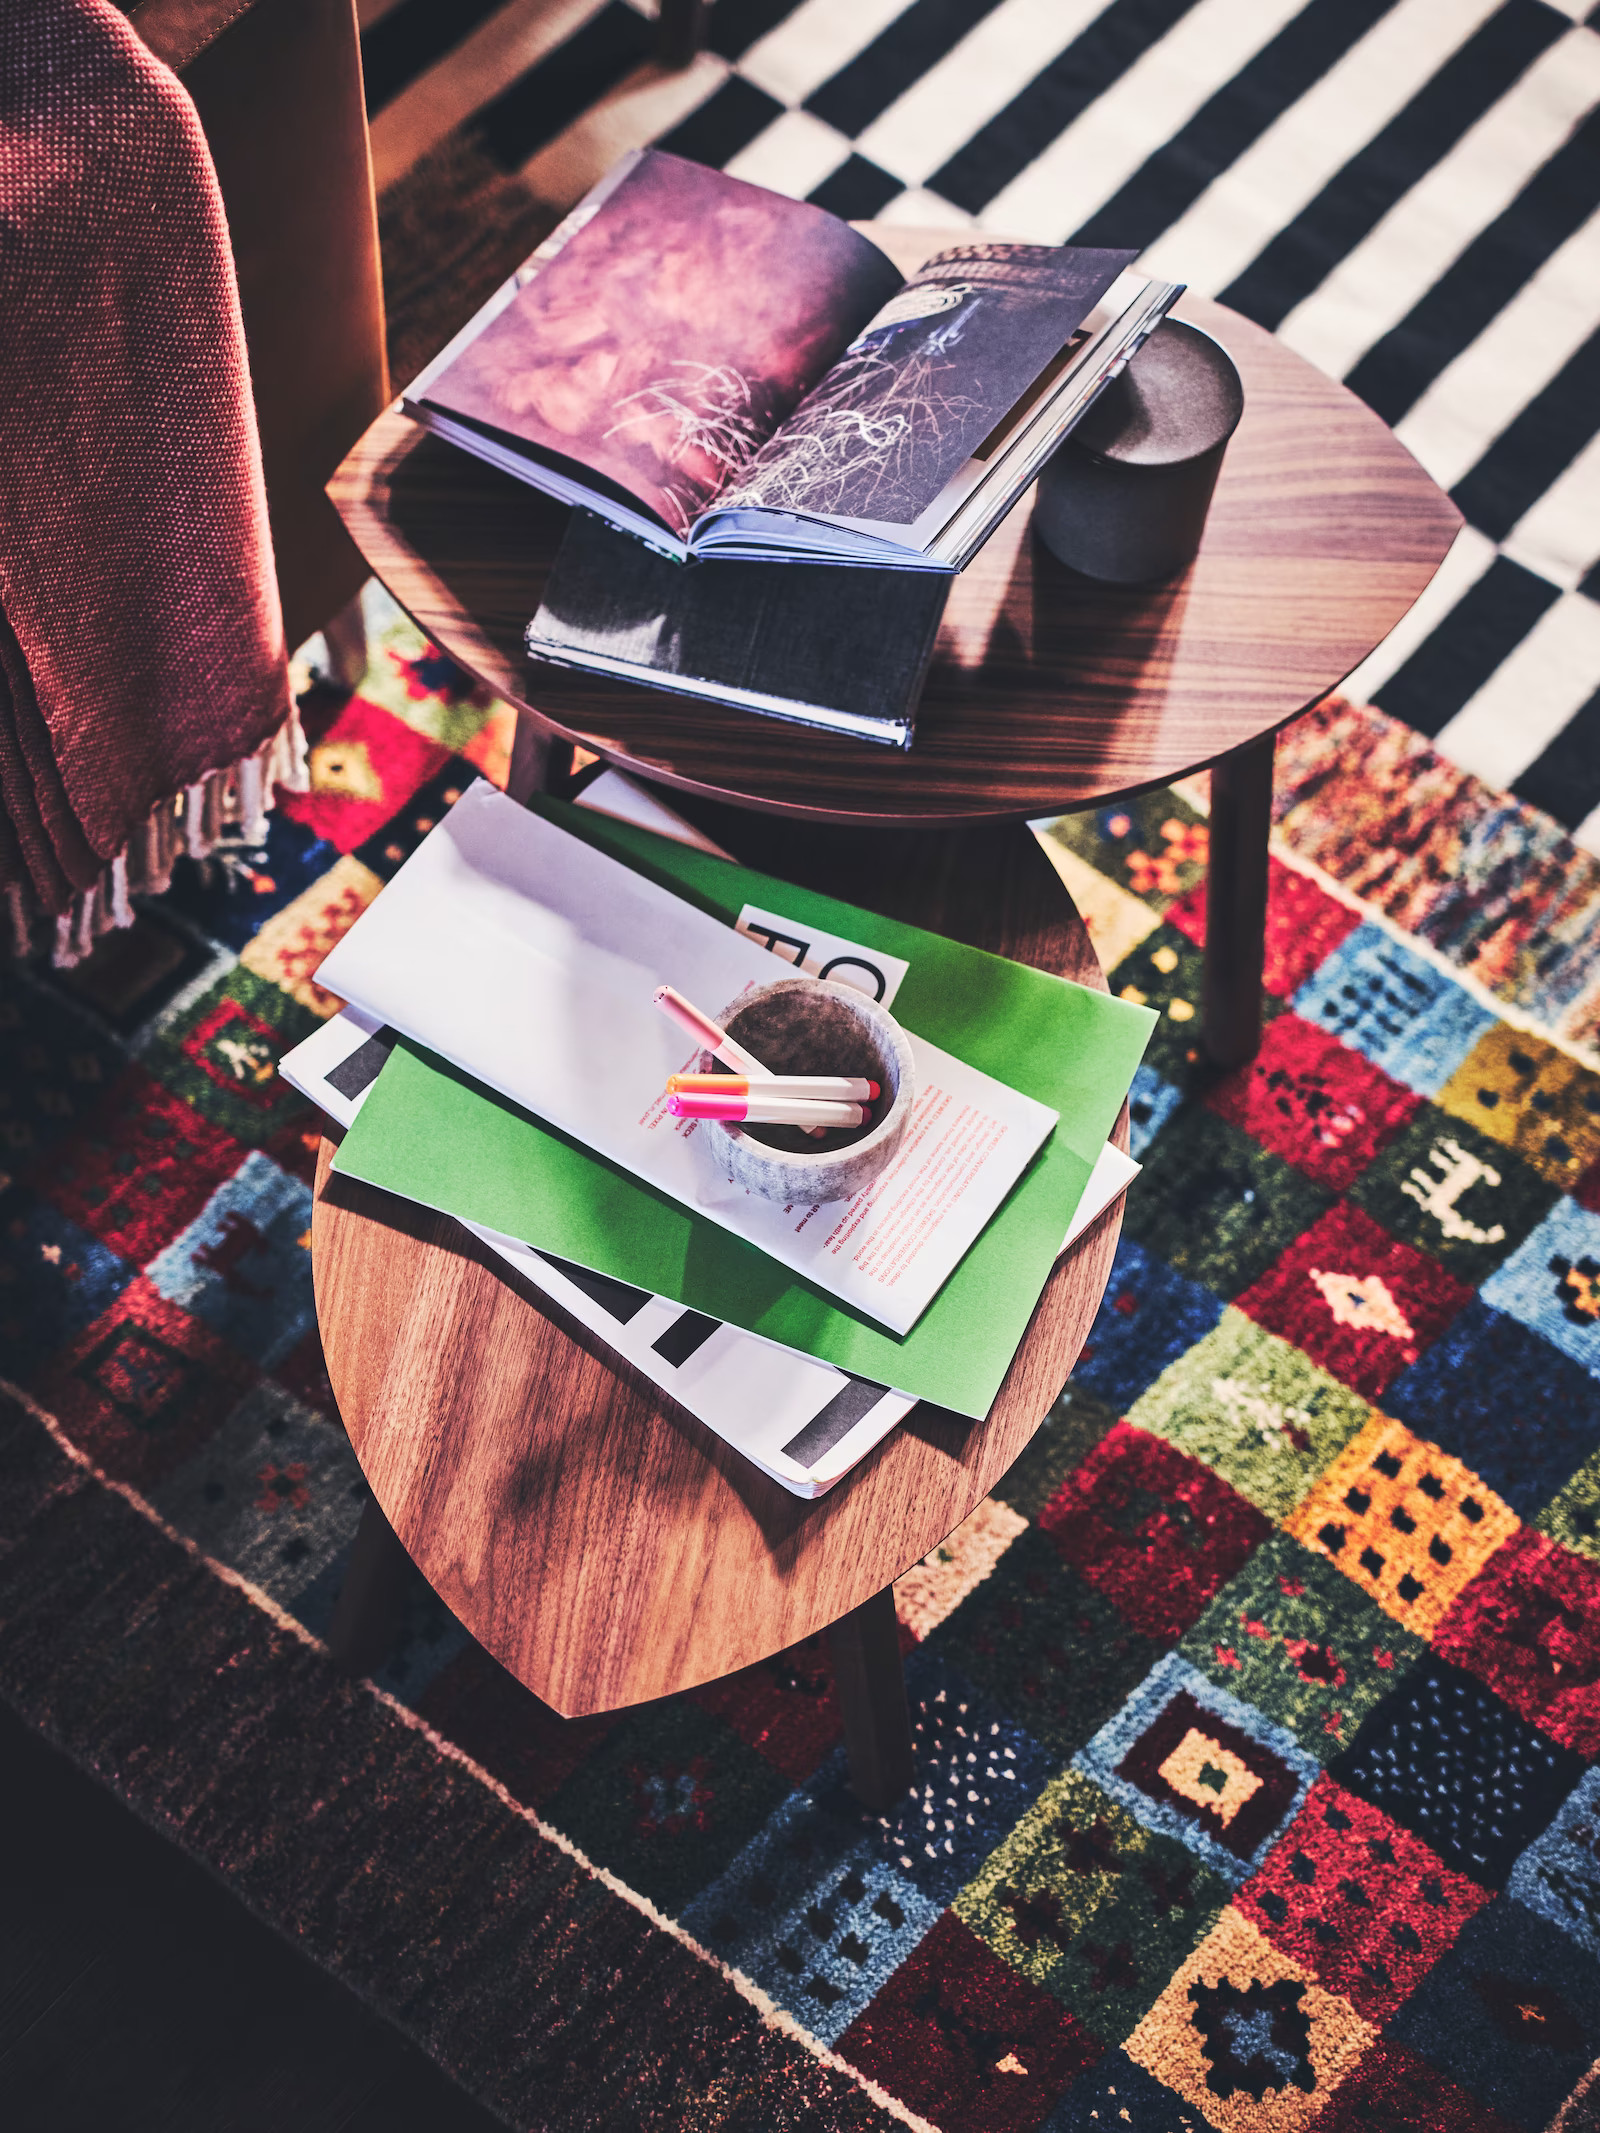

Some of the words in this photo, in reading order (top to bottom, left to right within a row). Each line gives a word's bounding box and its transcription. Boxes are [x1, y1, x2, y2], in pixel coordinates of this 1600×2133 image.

[932, 1094, 952, 1120] SKEWED
[648, 1113, 663, 1131] PIXEL
[908, 1130, 926, 1153] creative
[942, 1127, 954, 1141] from
[987, 1125, 1008, 1151] SKEWED
[907, 1174, 920, 1189] most
[924, 1172, 947, 1200] magazine
[950, 1151, 989, 1202] CONVERSATIONS
[867, 1180, 888, 1207] exploring
[890, 1188, 909, 1211] exciting
[847, 1197, 863, 1216] paired
[898, 1196, 916, 1218] change
[794, 1217, 808, 1233] meet
[833, 1223, 844, 1236] with
[838, 1217, 861, 1245] exploiting
[915, 1208, 935, 1234] SKEWED
[921, 1212, 944, 1241] magazine
[852, 1245, 867, 1262] world.
[877, 1233, 916, 1283] CONVERSATIONS
[880, 1234, 901, 1260] roadmap
[905, 1240, 923, 1263] devoted
[886, 1269, 902, 1288] ideas,
